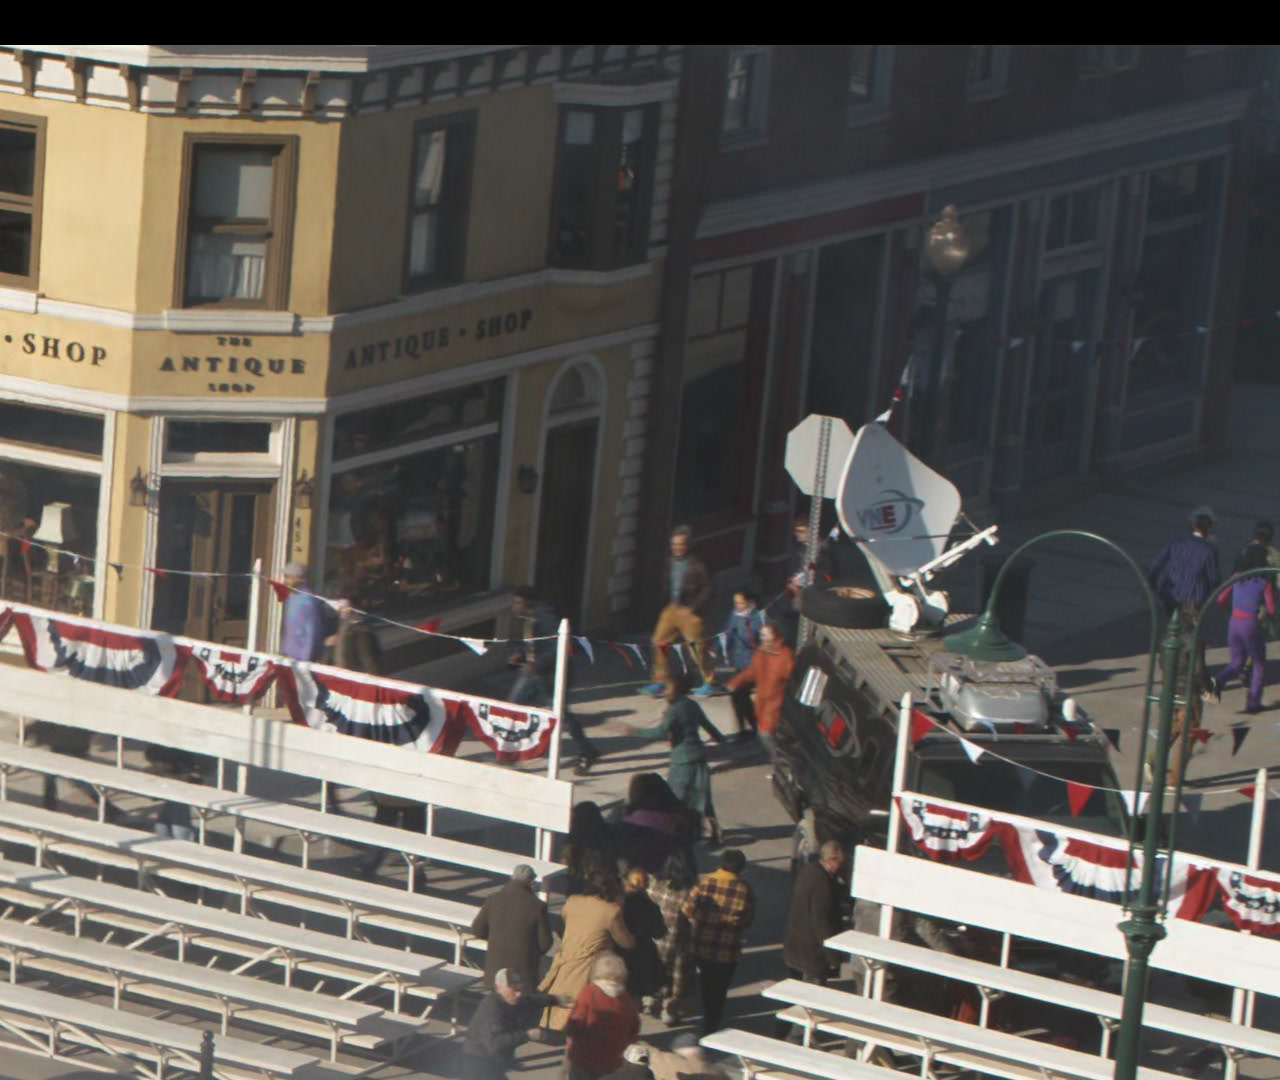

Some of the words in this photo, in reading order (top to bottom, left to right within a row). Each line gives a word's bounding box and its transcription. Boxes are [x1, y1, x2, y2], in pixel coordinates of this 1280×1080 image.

[22, 332, 108, 367] SHOP
[217, 336, 253, 348] THE
[344, 326, 450, 370] ANTIQUE
[475, 308, 533, 341] SHOP
[158, 356, 307, 378] ANTIQUE
[208, 383, 256, 393] SHOP
[856, 504, 897, 526] VNE
